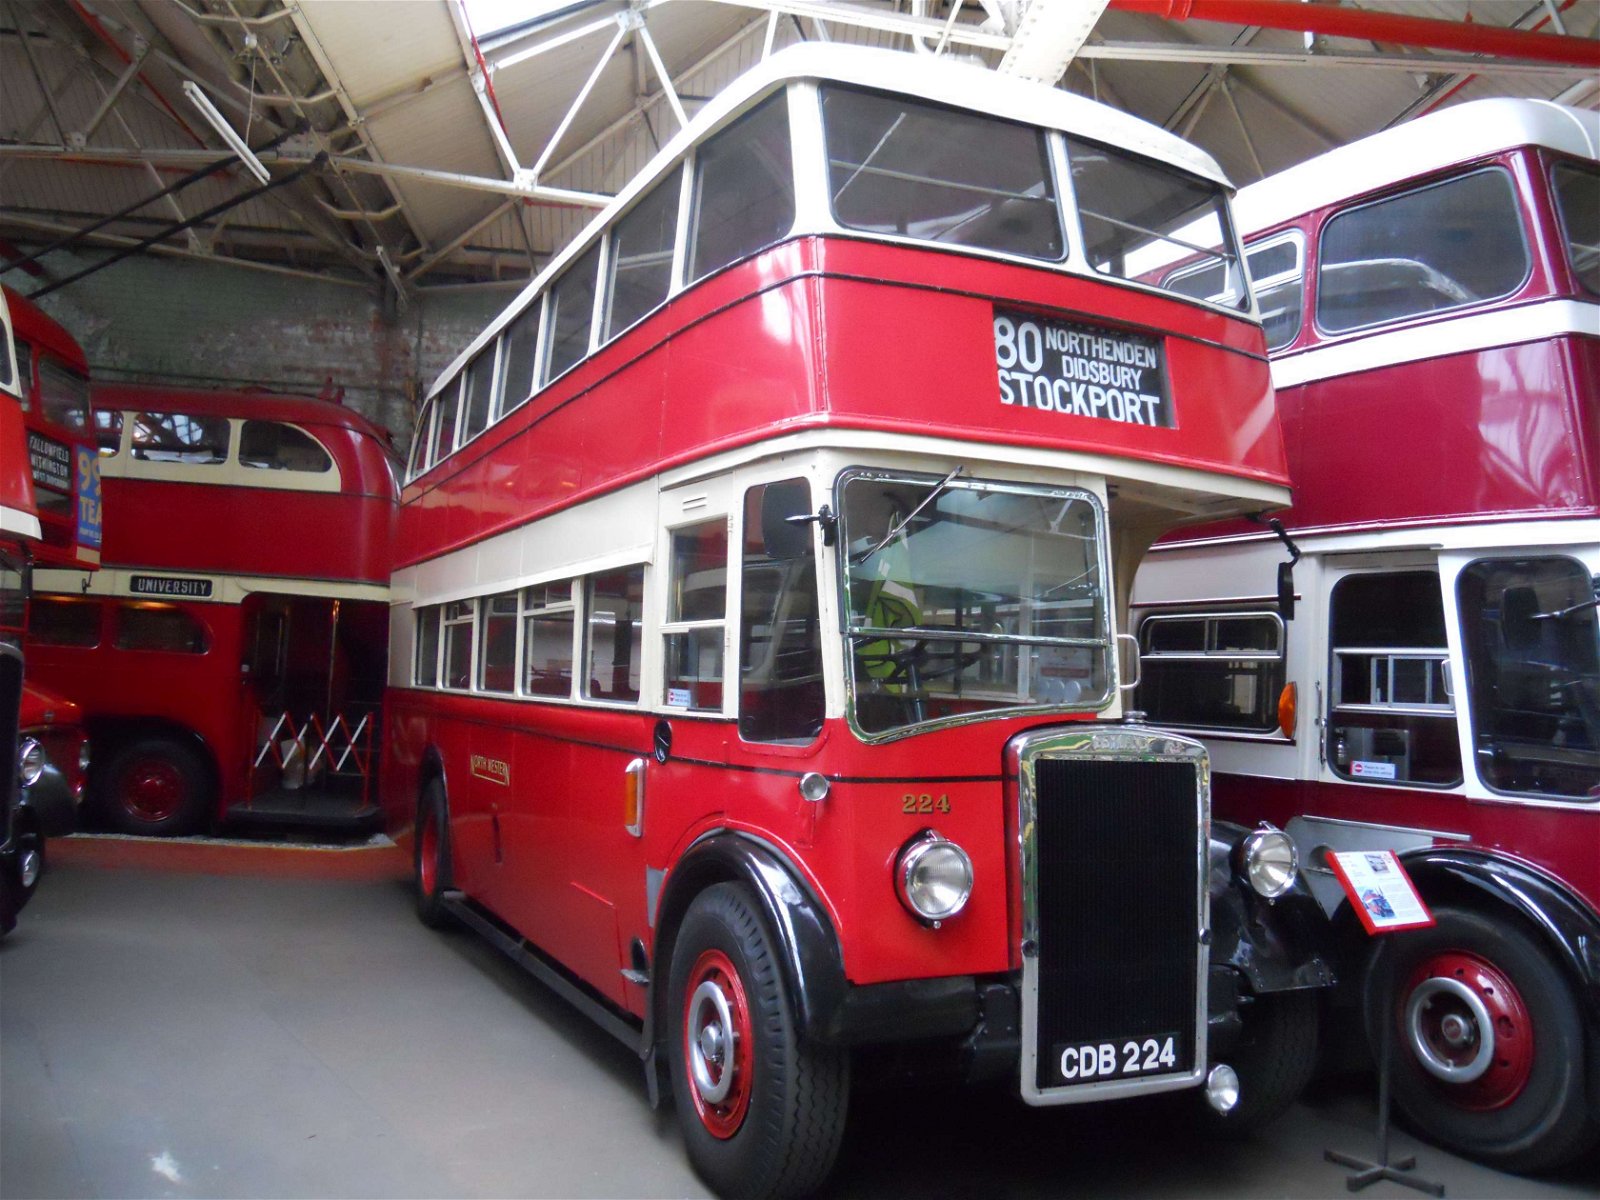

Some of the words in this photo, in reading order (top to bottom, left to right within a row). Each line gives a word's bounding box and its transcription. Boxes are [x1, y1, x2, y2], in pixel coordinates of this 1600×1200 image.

[993, 316, 1043, 372] 80
[1045, 326, 1156, 369] NORTHENDEN
[1061, 355, 1142, 391] DIDSBURY
[997, 369, 1160, 427] STOCKPORT
[137, 578, 207, 595] UNIVERSITY
[902, 793, 950, 814] 224
[1061, 1043, 1117, 1079] CDB
[1122, 1037, 1176, 1073] 224
